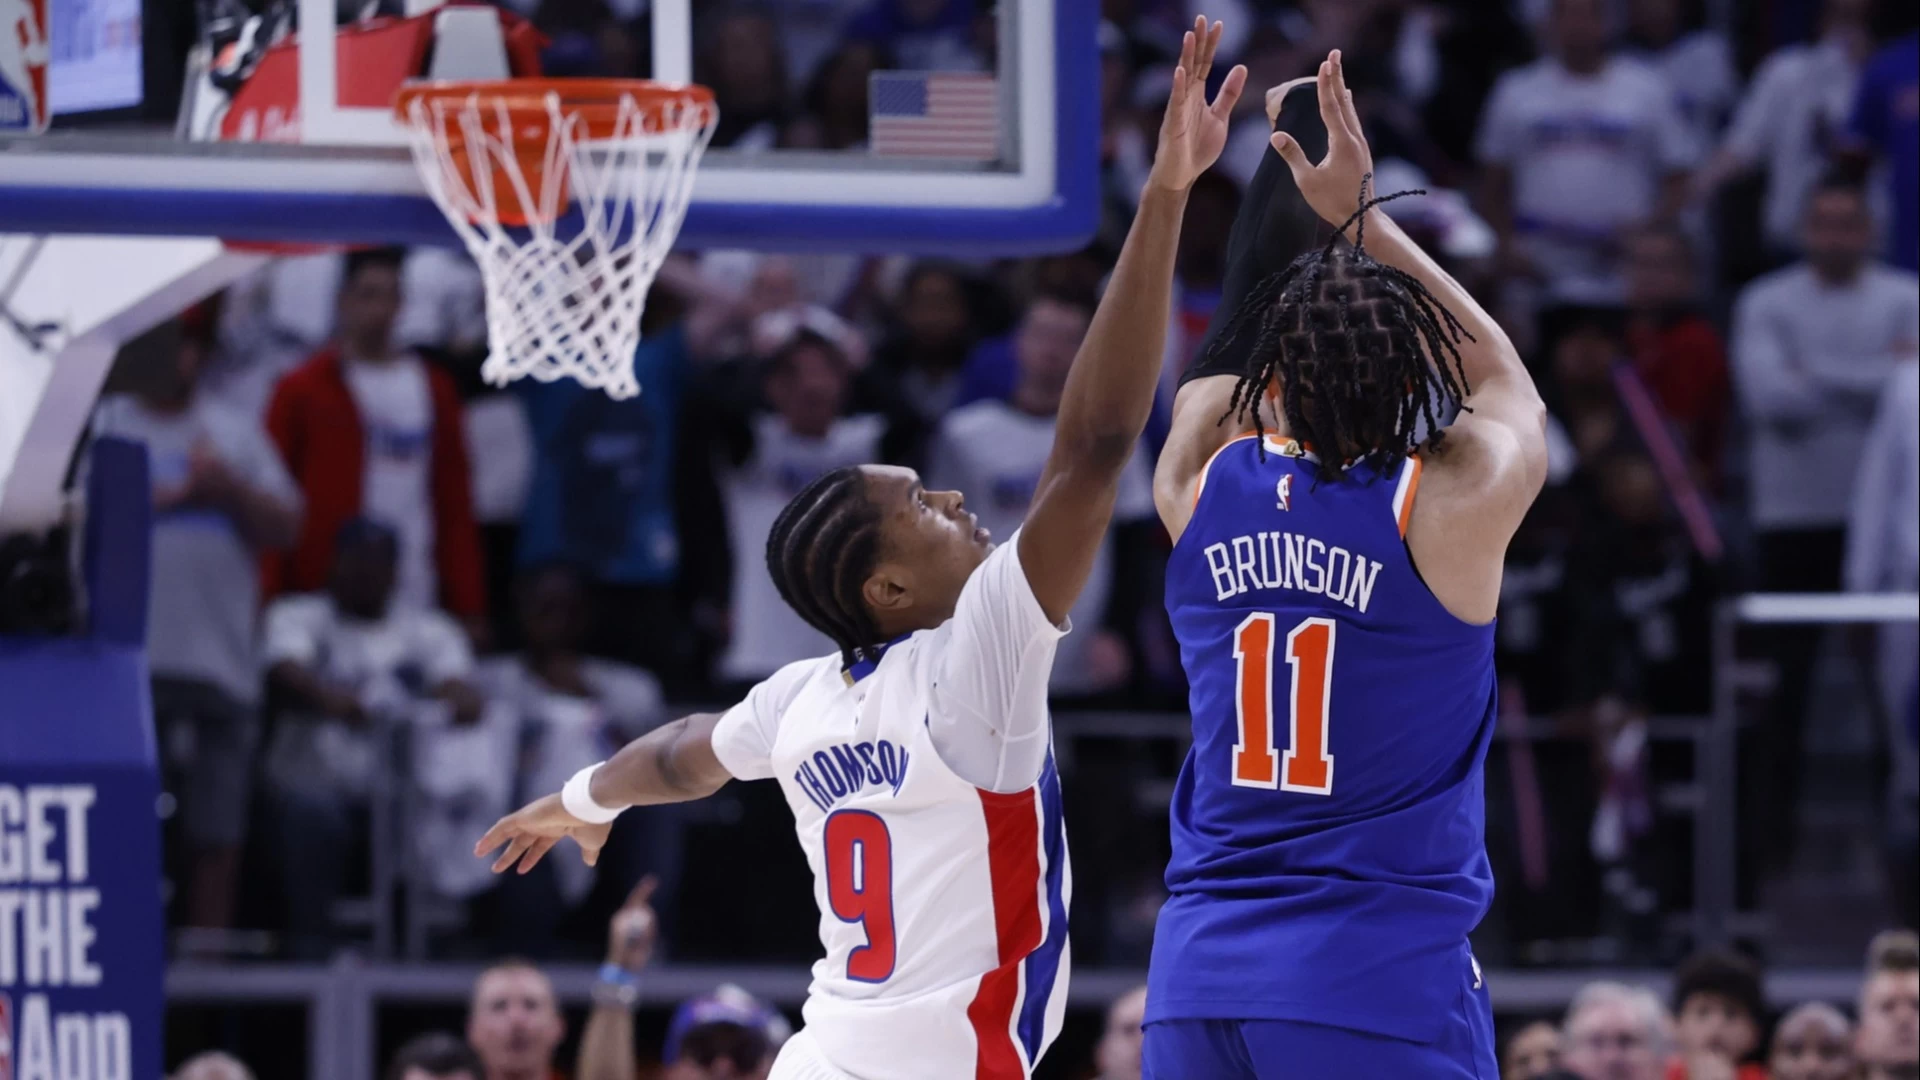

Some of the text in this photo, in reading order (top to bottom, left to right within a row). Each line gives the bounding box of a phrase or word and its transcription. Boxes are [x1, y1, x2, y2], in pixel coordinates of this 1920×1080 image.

[1204, 531, 1383, 614] BRUNSON
[1231, 611, 1336, 796] 11
[0, 783, 97, 883] GET
[0, 887, 102, 987] THE
[823, 808, 897, 984] 9
